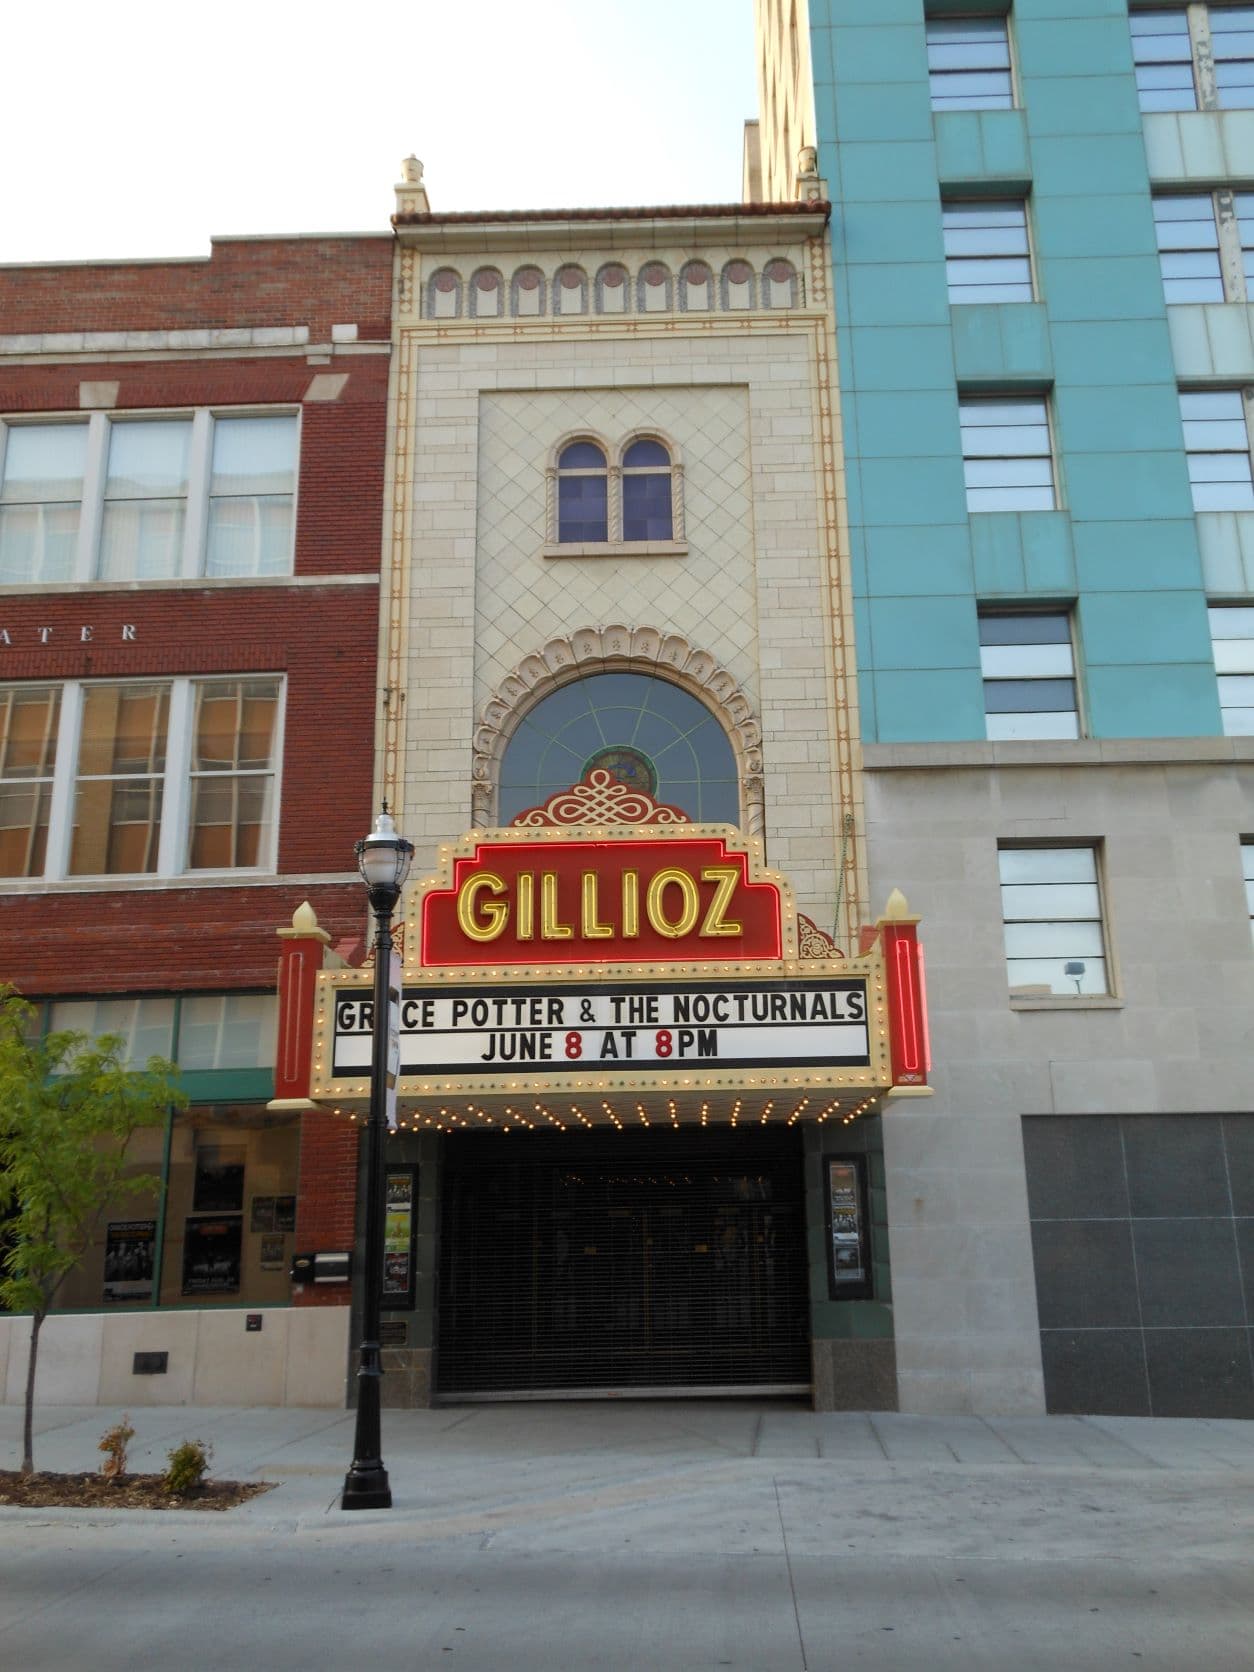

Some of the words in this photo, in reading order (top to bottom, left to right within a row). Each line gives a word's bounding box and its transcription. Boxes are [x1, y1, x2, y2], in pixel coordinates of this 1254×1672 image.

[456, 866, 742, 942] GILLIOZ
[337, 1000, 434, 1030] GRCE
[452, 997, 565, 1027] POTTER
[579, 998, 596, 1023] &
[610, 996, 659, 1024] THE
[673, 992, 864, 1023] NOCTURNALS
[481, 1032, 552, 1061] JUNE
[565, 1031, 582, 1059] 8
[600, 1030, 637, 1059] AT
